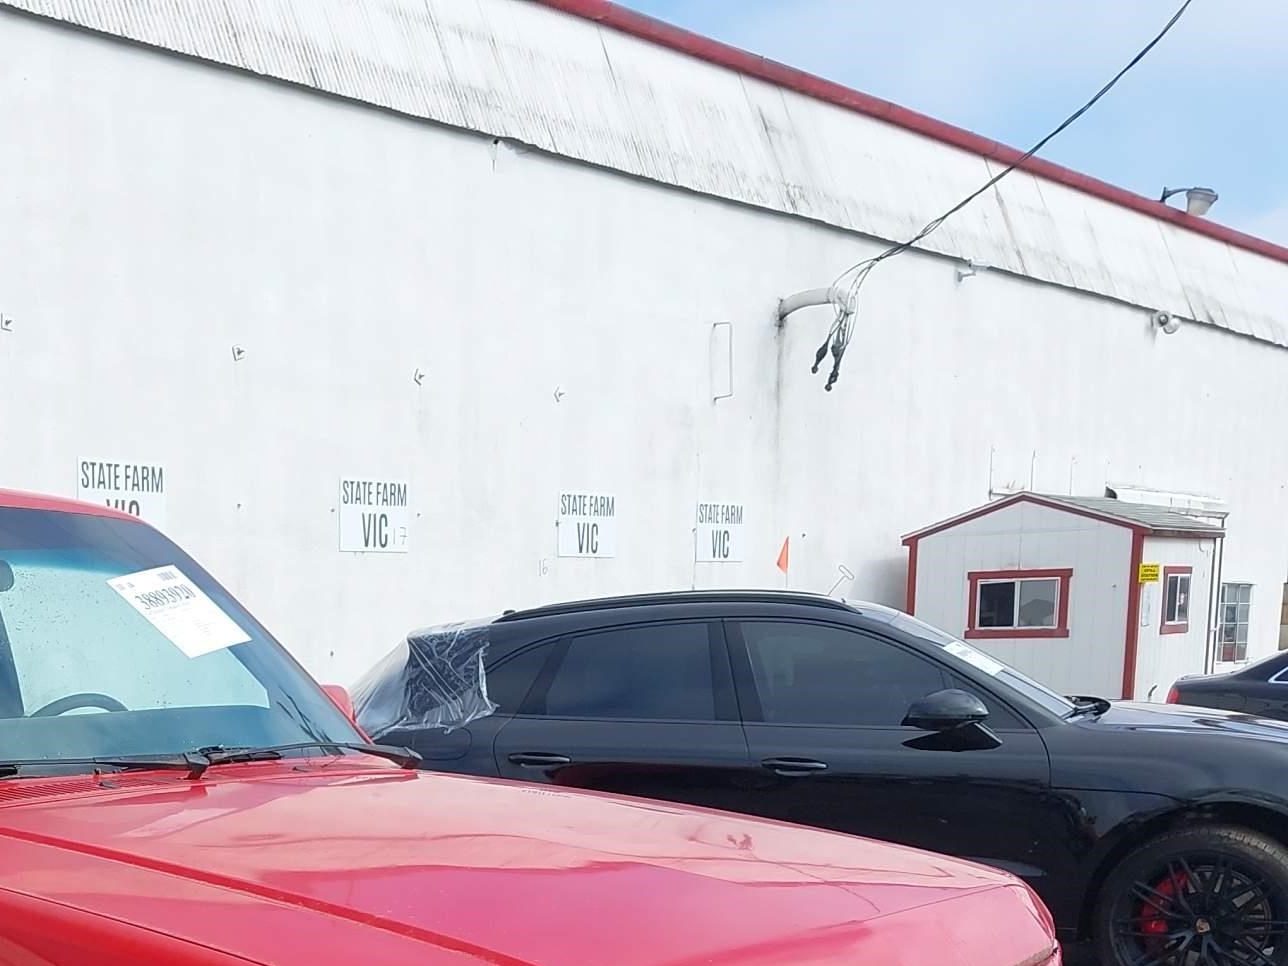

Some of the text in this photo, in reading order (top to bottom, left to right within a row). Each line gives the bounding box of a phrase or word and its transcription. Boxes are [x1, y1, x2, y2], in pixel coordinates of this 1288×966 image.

[81, 461, 163, 493] STATE FARM
[342, 480, 407, 507] STATE FARM
[560, 494, 615, 517] STATE FARM
[699, 504, 743, 524] STATE FARM
[361, 512, 388, 548] VIC
[576, 522, 599, 554] VIC
[711, 529, 730, 559] VIC
[135, 583, 197, 610] 38893920
